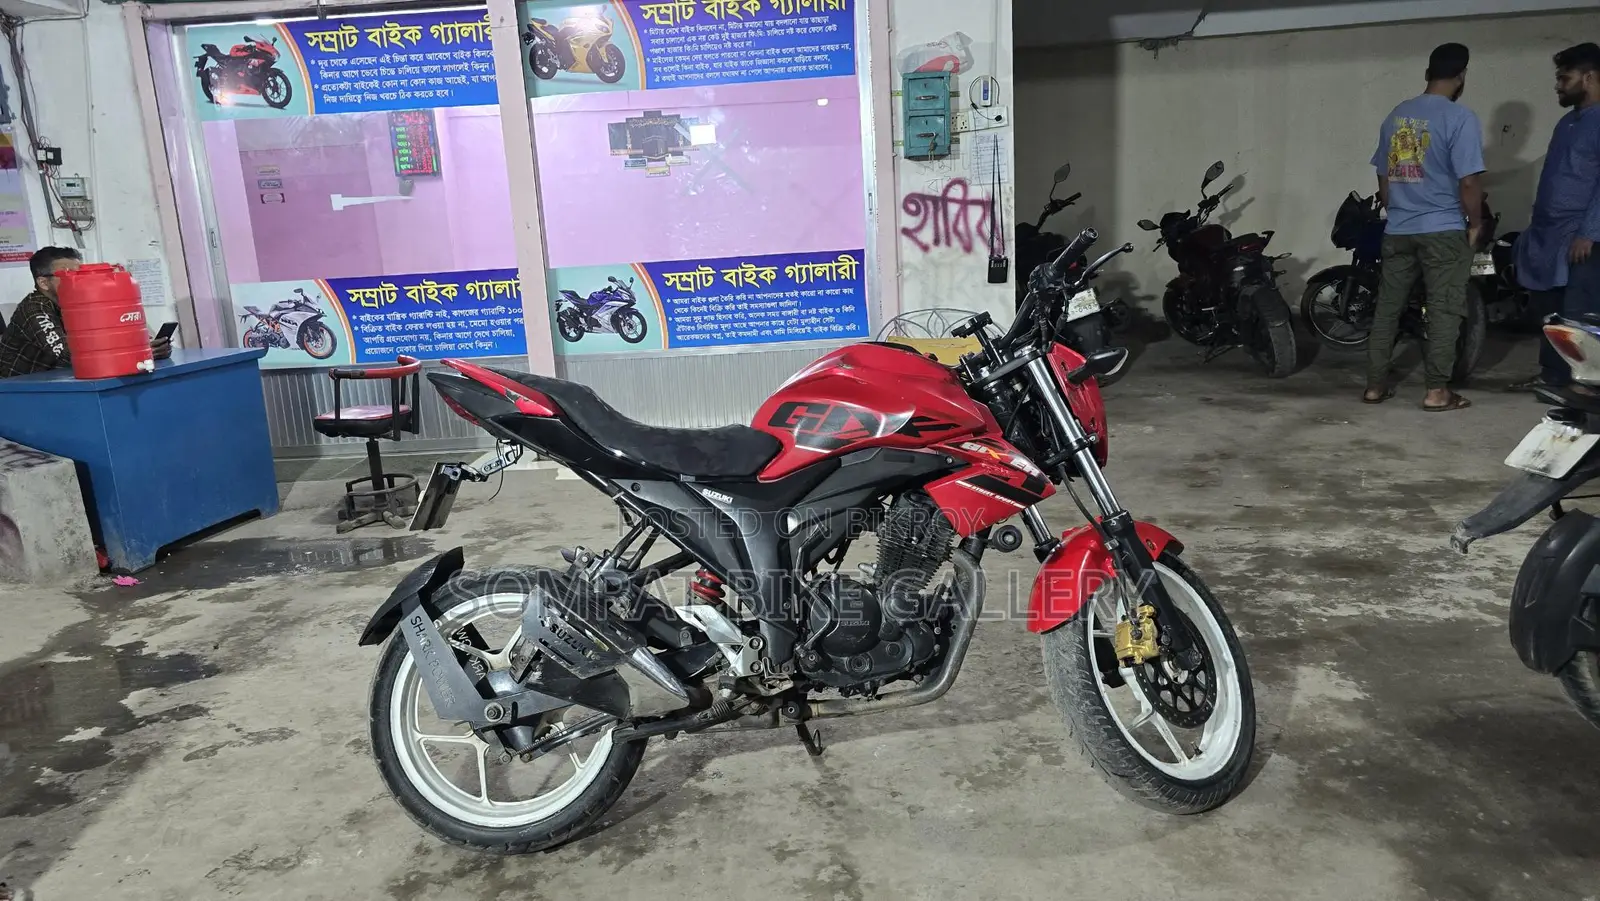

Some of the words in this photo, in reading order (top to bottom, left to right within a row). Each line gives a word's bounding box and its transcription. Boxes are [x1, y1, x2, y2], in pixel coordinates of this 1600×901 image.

[640, 0, 697, 27] সম্রাট
[704, 0, 762, 21] বাইক
[304, 22, 360, 54] সম্রাট
[364, 20, 423, 49] বাইক
[662, 264, 717, 293] সম্রাট
[720, 262, 778, 289] বাইক
[785, 253, 860, 285] গ্যালারী
[346, 280, 399, 309] সম্রাট
[403, 278, 460, 305] বাইক
[702, 487, 734, 505] SUZUKI
[410, 615, 437, 659] SHARK
